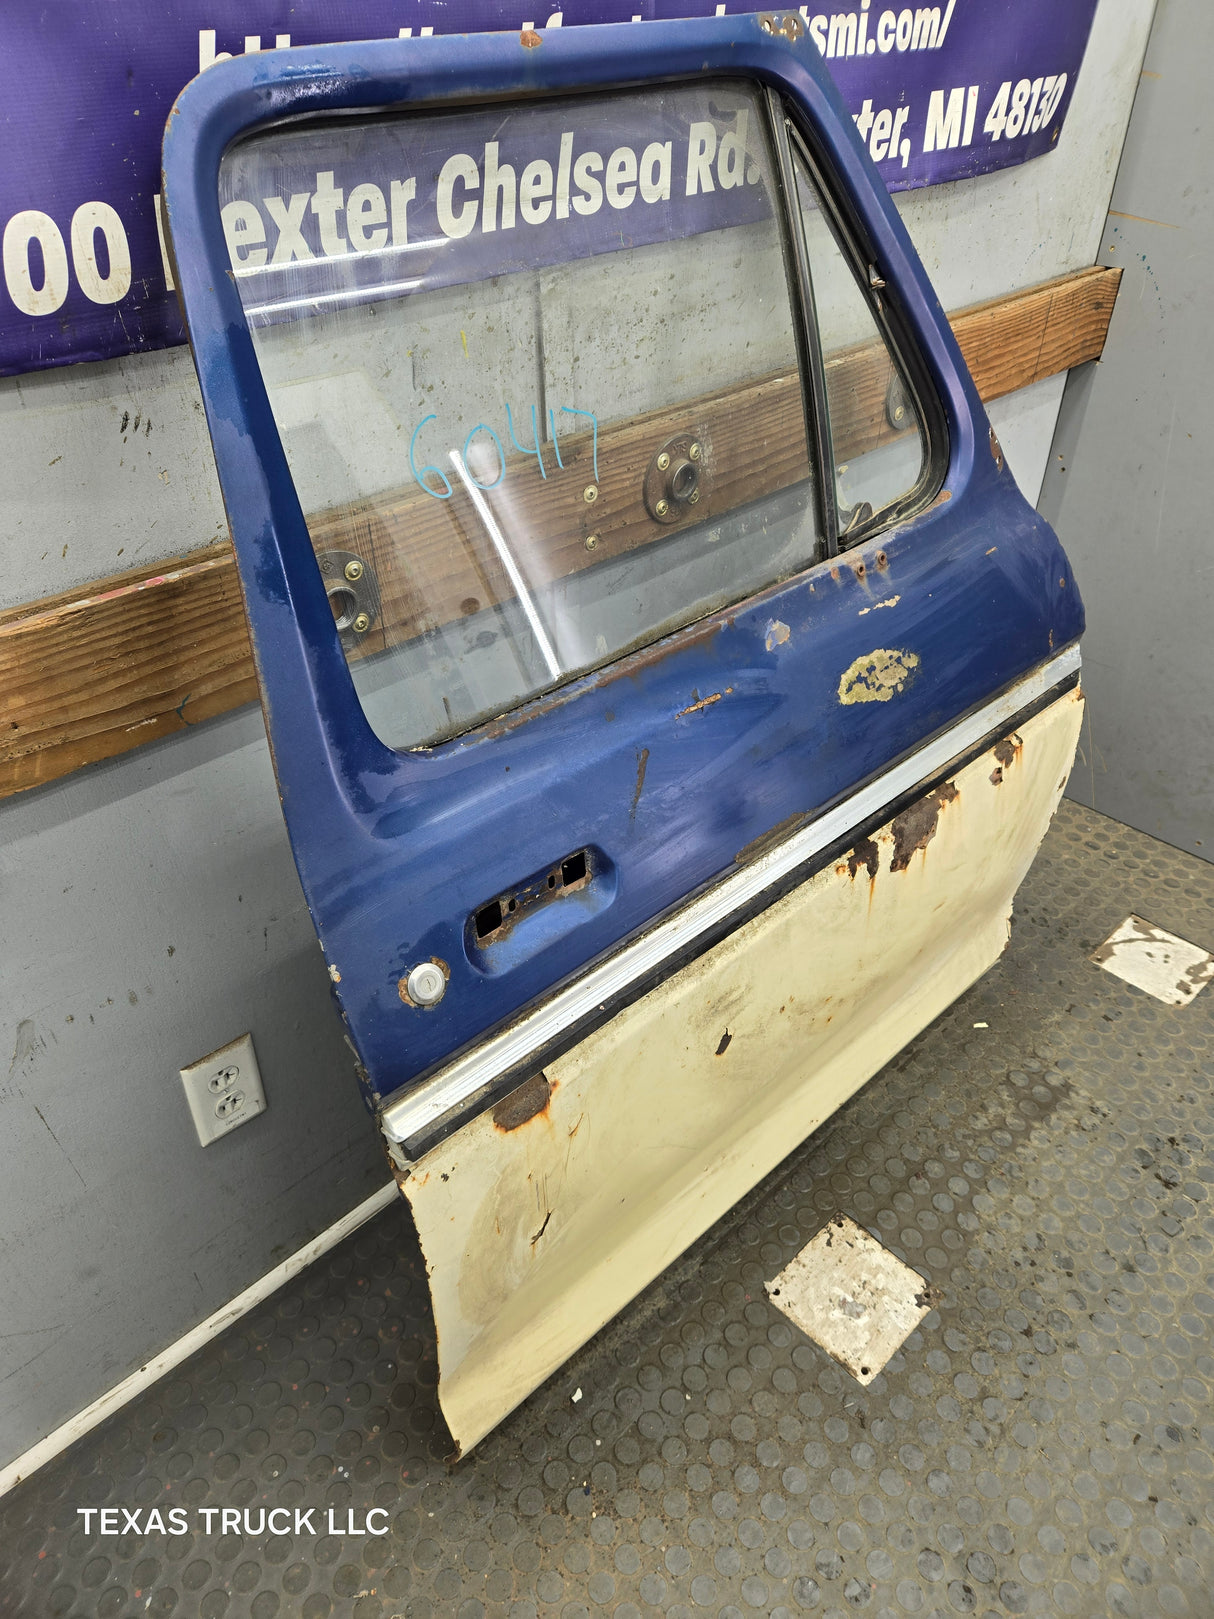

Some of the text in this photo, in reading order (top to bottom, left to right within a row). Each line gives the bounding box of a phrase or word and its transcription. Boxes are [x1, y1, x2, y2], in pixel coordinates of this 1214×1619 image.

[923, 85, 980, 153] MI
[983, 72, 1068, 142] 48130
[153, 171, 416, 291] exter
[436, 131, 673, 239] Chelsea
[685, 108, 761, 196] Rd.
[410, 402, 599, 499] 60417
